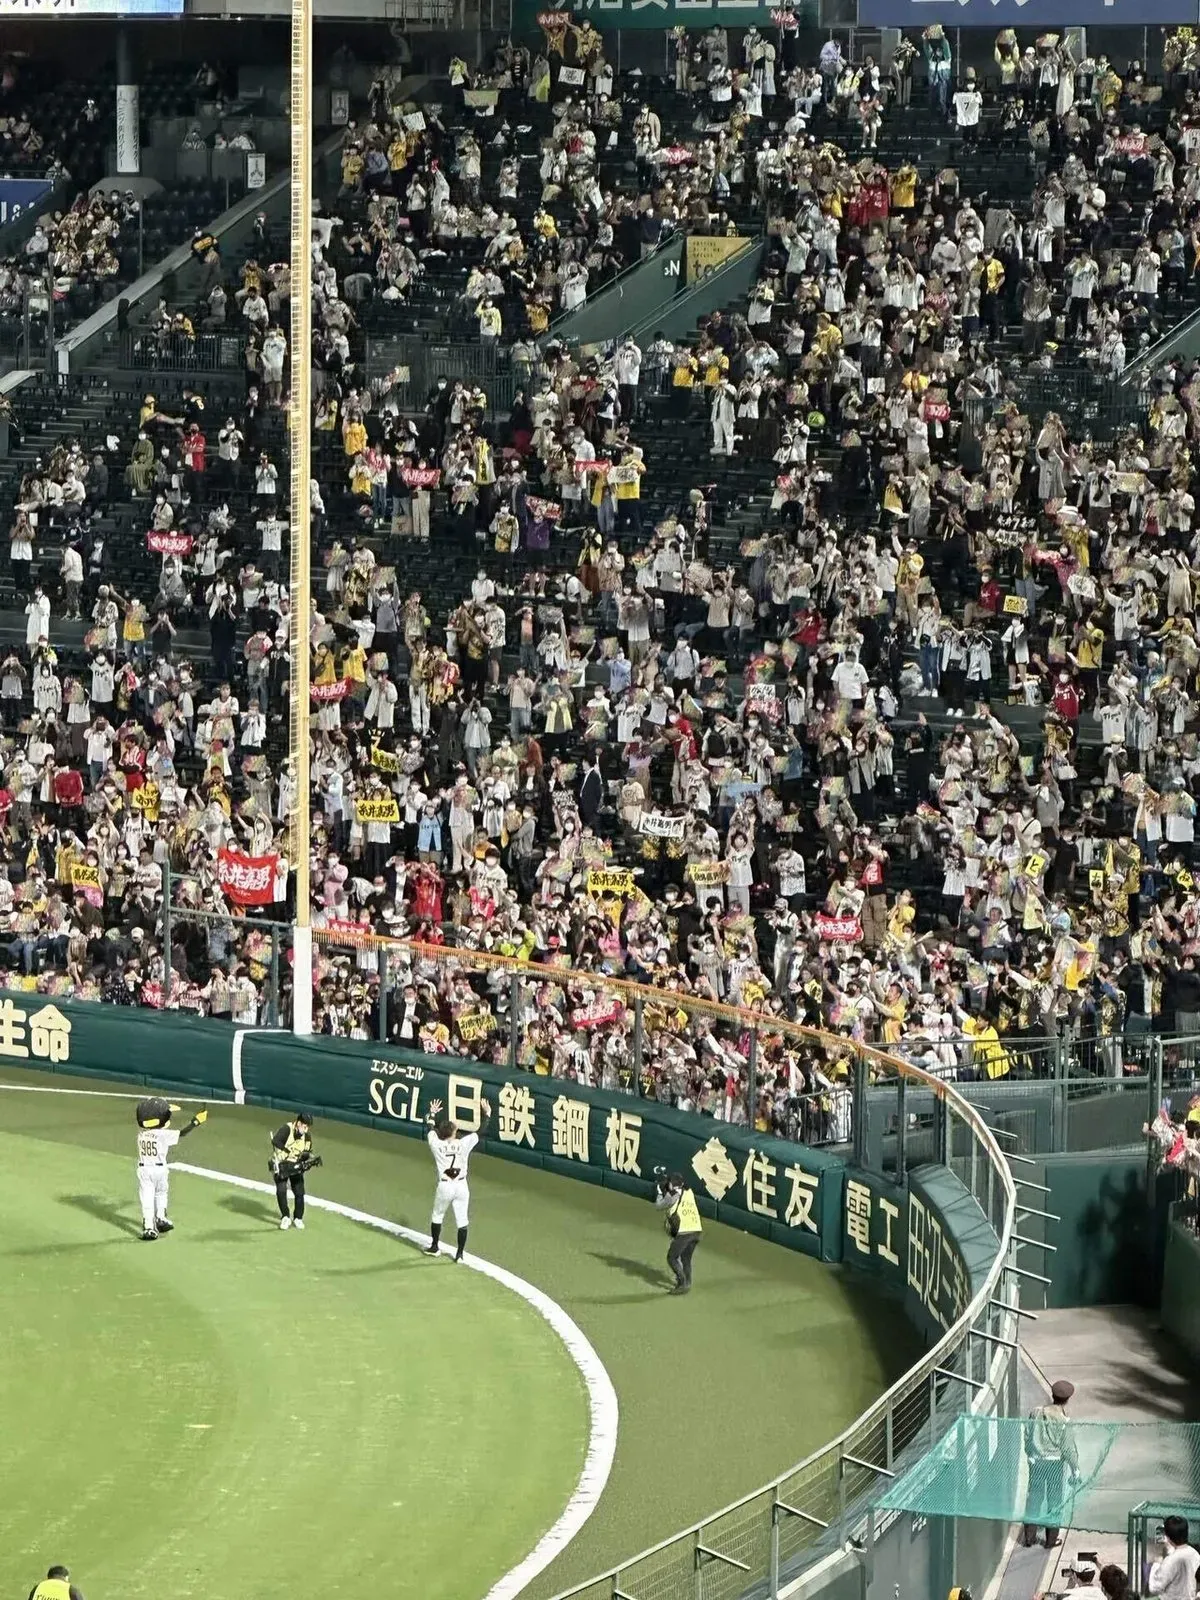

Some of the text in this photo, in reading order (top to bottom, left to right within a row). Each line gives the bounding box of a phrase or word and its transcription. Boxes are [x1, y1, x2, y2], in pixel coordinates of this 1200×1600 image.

[370, 1059, 425, 1081] エスシーエル
[368, 1074, 643, 1178] SGL 日鉄鋼板
[445, 1153, 456, 1169] 7
